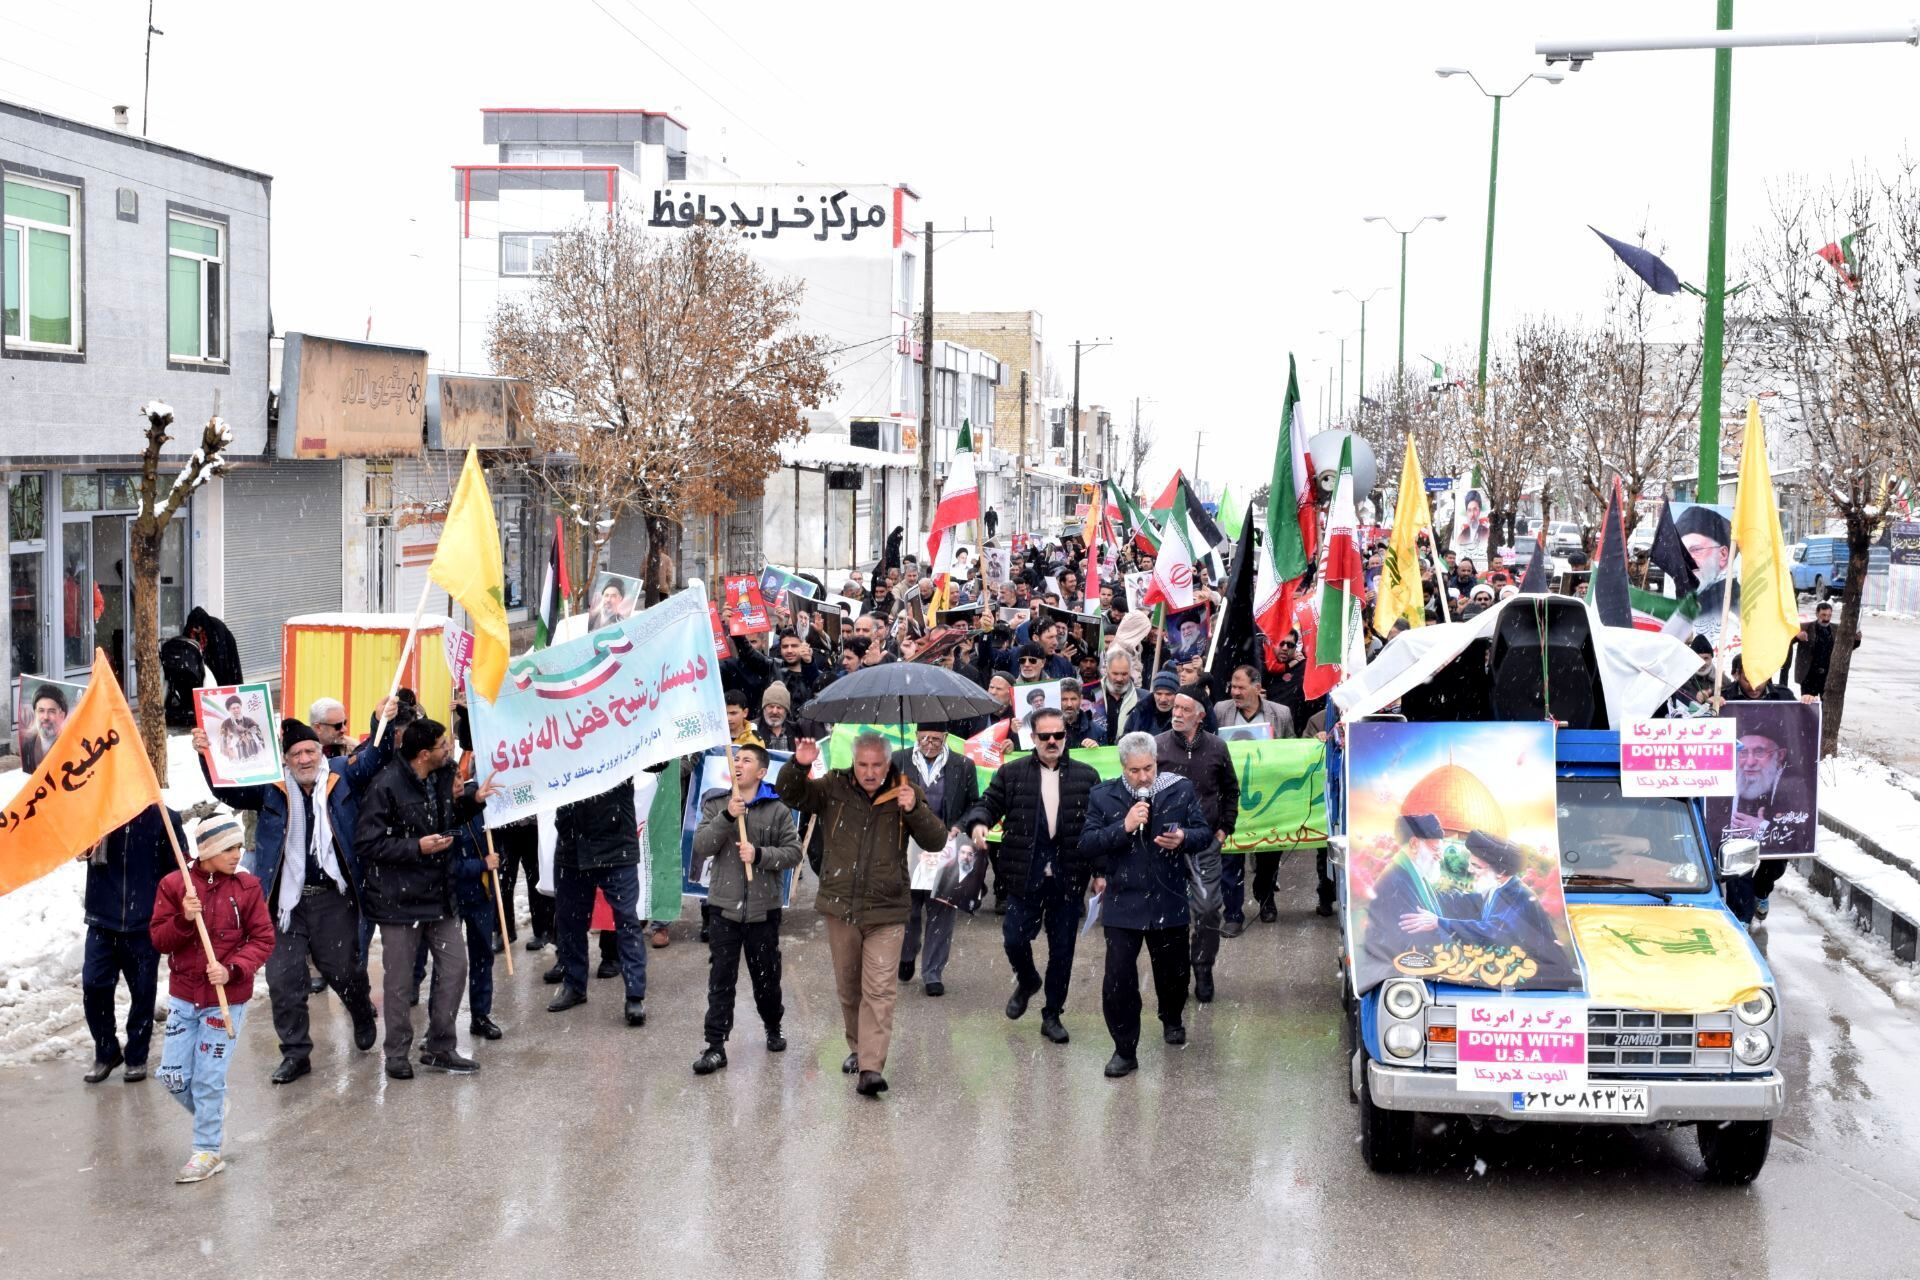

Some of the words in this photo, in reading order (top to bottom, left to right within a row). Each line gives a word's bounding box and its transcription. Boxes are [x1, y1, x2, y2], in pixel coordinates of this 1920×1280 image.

[730, 195, 815, 240] خرید
[813, 189, 886, 241] مرکز
[648, 654, 708, 711] دبستان
[608, 678, 649, 727] شیخ
[562, 700, 611, 750] فضل
[1633, 723, 1672, 741] امریکا
[1676, 727, 1687, 741] بر
[490, 721, 534, 772] نوری
[1631, 745, 1679, 757] DOWN
[1683, 744, 1724, 757] WITH
[61, 728, 120, 792] مطیع
[1655, 758, 1697, 770] U.S.A
[1683, 775, 1719, 788] الموت
[24, 771, 57, 820] امر
[1471, 1008, 1515, 1028] امریکا
[1519, 1013, 1533, 1028] بر
[1536, 1009, 1572, 1029] مرگ
[1468, 1032, 1523, 1047] DOWN
[1527, 1033, 1574, 1048] WITH
[1614, 1034, 1663, 1047] ZAMYAD
[1495, 1048, 1542, 1062] U.S.A
[1527, 1069, 1569, 1084] الموت
